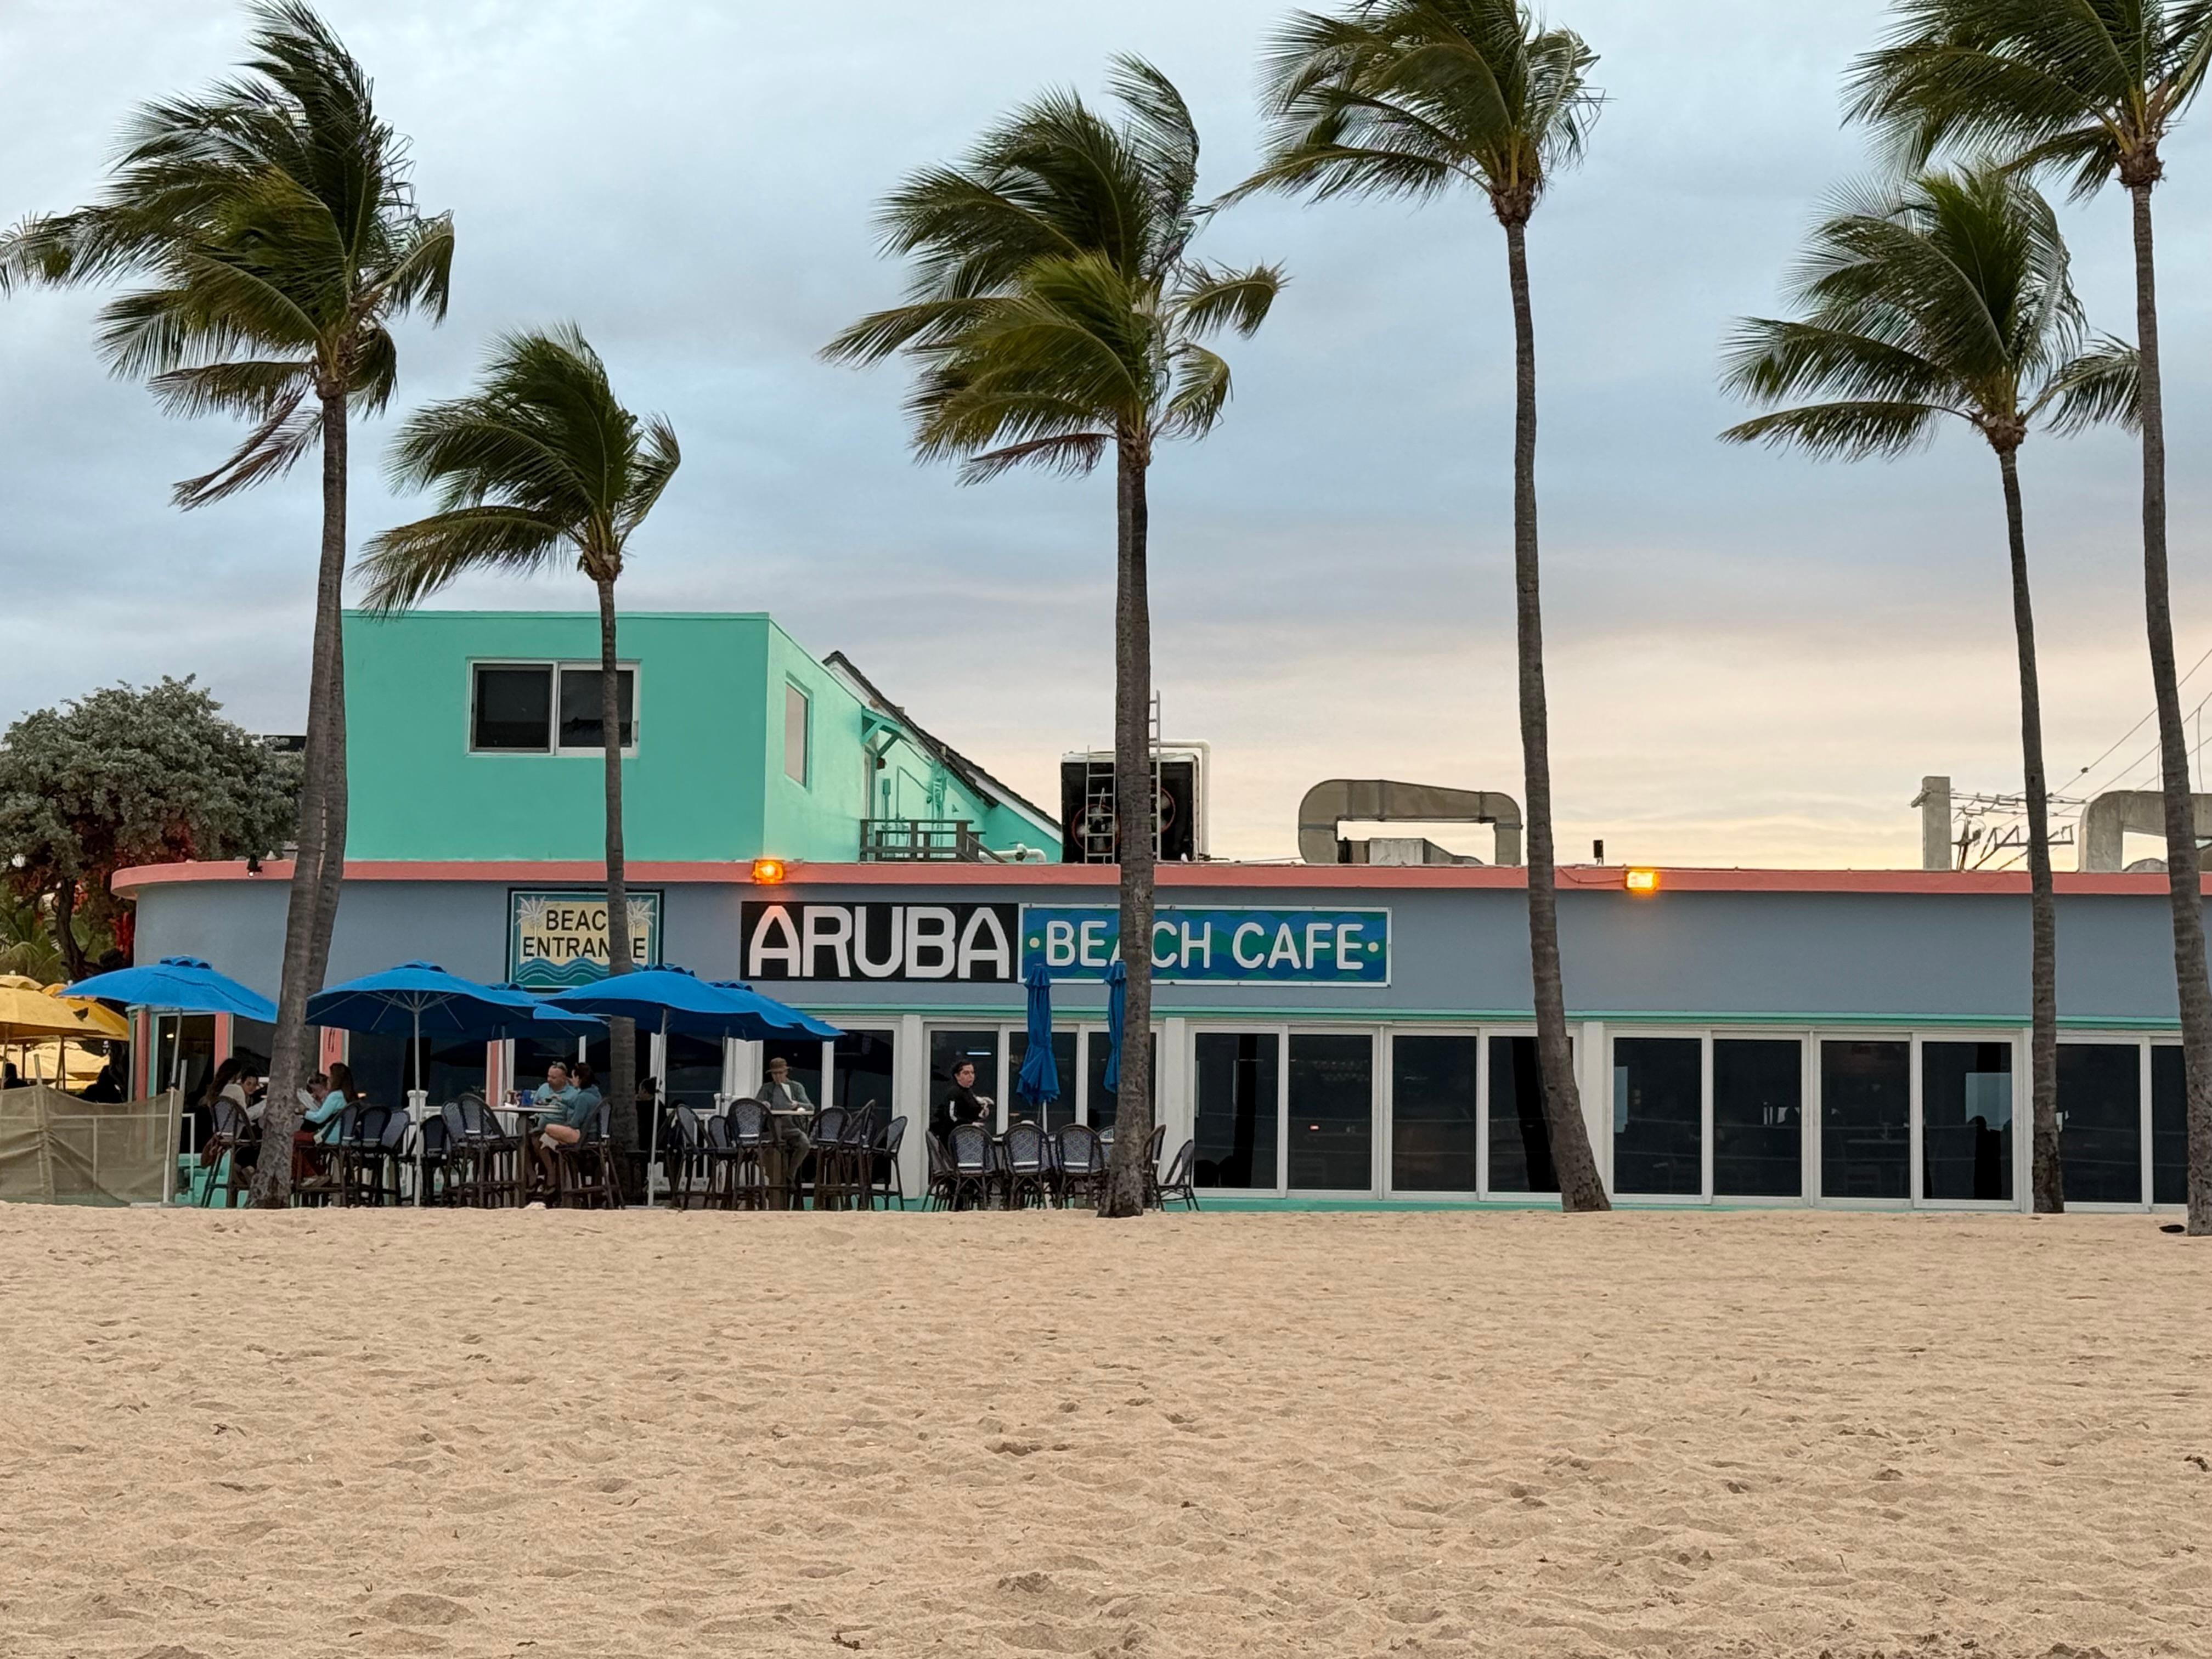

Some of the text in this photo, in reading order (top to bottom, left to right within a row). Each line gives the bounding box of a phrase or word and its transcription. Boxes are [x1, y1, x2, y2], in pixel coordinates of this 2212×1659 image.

[545, 909, 607, 932] BEAC
[523, 936, 646, 958] ENTRANE
[748, 905, 1010, 979] ARUBA
[1046, 921, 1364, 970] BECH CAFE
